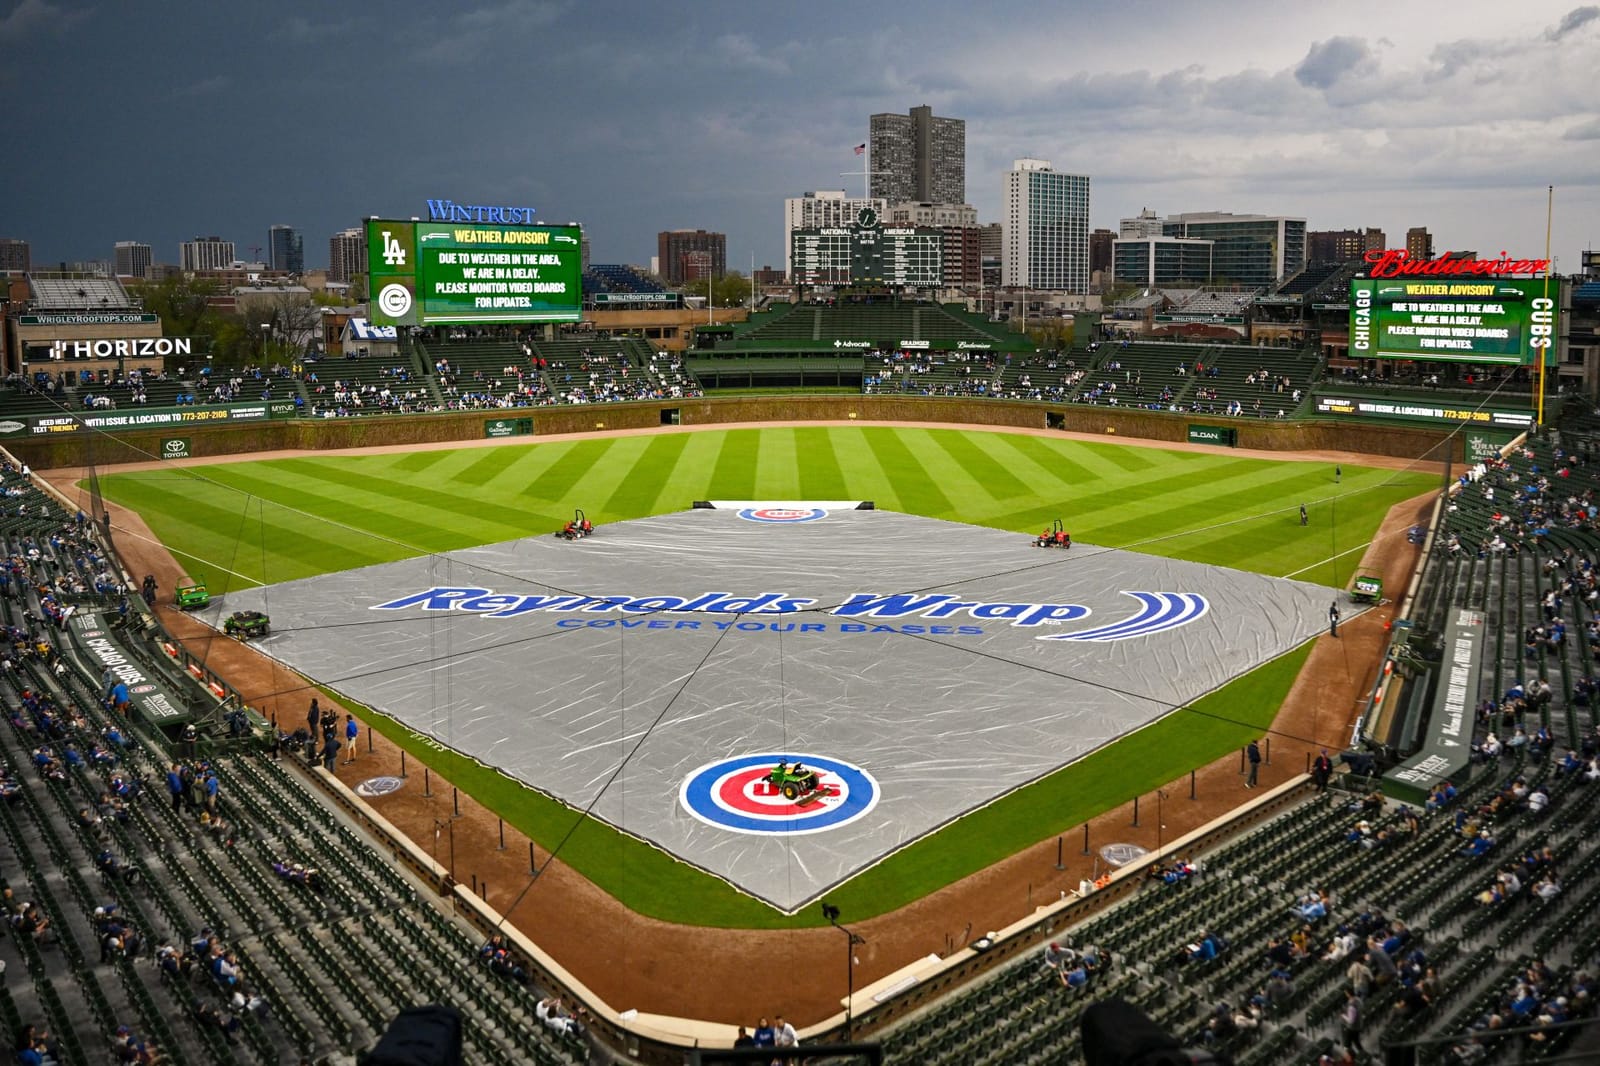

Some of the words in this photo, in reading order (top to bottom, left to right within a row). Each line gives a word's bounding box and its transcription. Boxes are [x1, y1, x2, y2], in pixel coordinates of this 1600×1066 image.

[455, 230, 501, 243] WEATHER
[502, 231, 550, 244] ADVISORY
[382, 231, 405, 265] LA
[439, 252, 457, 264] DUE
[458, 253, 470, 264] TO
[471, 253, 511, 265] WEATHER
[512, 254, 521, 265] IN
[522, 254, 538, 265] THE
[539, 254, 561, 266] AREA,
[1364, 250, 1551, 279] Budweiser
[463, 268, 477, 279] WE
[478, 268, 494, 279] ARE
[495, 268, 504, 279] IN
[505, 269, 512, 279] A
[513, 269, 540, 279] DELAY.
[435, 282, 468, 294] PLEASE
[469, 282, 508, 293] MONITOR
[509, 282, 533, 293] VIDEO
[534, 282, 566, 293] BOARDS
[1406, 285, 1448, 295] WEATHER
[1449, 285, 1495, 296] ADVISORY
[475, 297, 492, 308] FOR
[493, 297, 532, 308] UPDATES.
[1392, 303, 1407, 312] DUE
[1408, 303, 1418, 312] TO
[1419, 304, 1455, 313] WEATHER
[1456, 304, 1464, 313] IN
[1466, 304, 1481, 313] THE
[1482, 304, 1505, 314] AREA,
[37, 315, 142, 323] WRIGLEYROOFTOPS.COM
[1354, 289, 1371, 350] CHICAGO
[1411, 315, 1424, 324] WE
[1424, 315, 1439, 324] ARE
[1449, 315, 1455, 324] A
[1530, 298, 1553, 349] CUBS
[1388, 326, 1415, 335] PLEASE
[1416, 327, 1450, 336] MONITOR
[1452, 328, 1474, 337] VIDEO
[1475, 329, 1508, 338] BOARDS
[74, 338, 191, 357] HORIZON
[1421, 339, 1436, 347] FOR
[85, 418, 105, 426] WITH
[106, 417, 127, 425] ISSUE
[129, 416, 135, 424] &
[137, 414, 171, 424] LOCATION
[172, 413, 181, 421] TO
[182, 410, 227, 420] 773-207-2106
[1434, 409, 1443, 417] TO
[1190, 431, 1218, 439] SLOAN
[368, 585, 820, 618] Reynolds
[830, 593, 1093, 627] Wrap
[557, 619, 702, 630] COVER
[708, 621, 825, 632] YOUR
[840, 624, 984, 635] BASES
[86, 638, 127, 666] CHICAGO
[112, 664, 147, 686] CUBS
